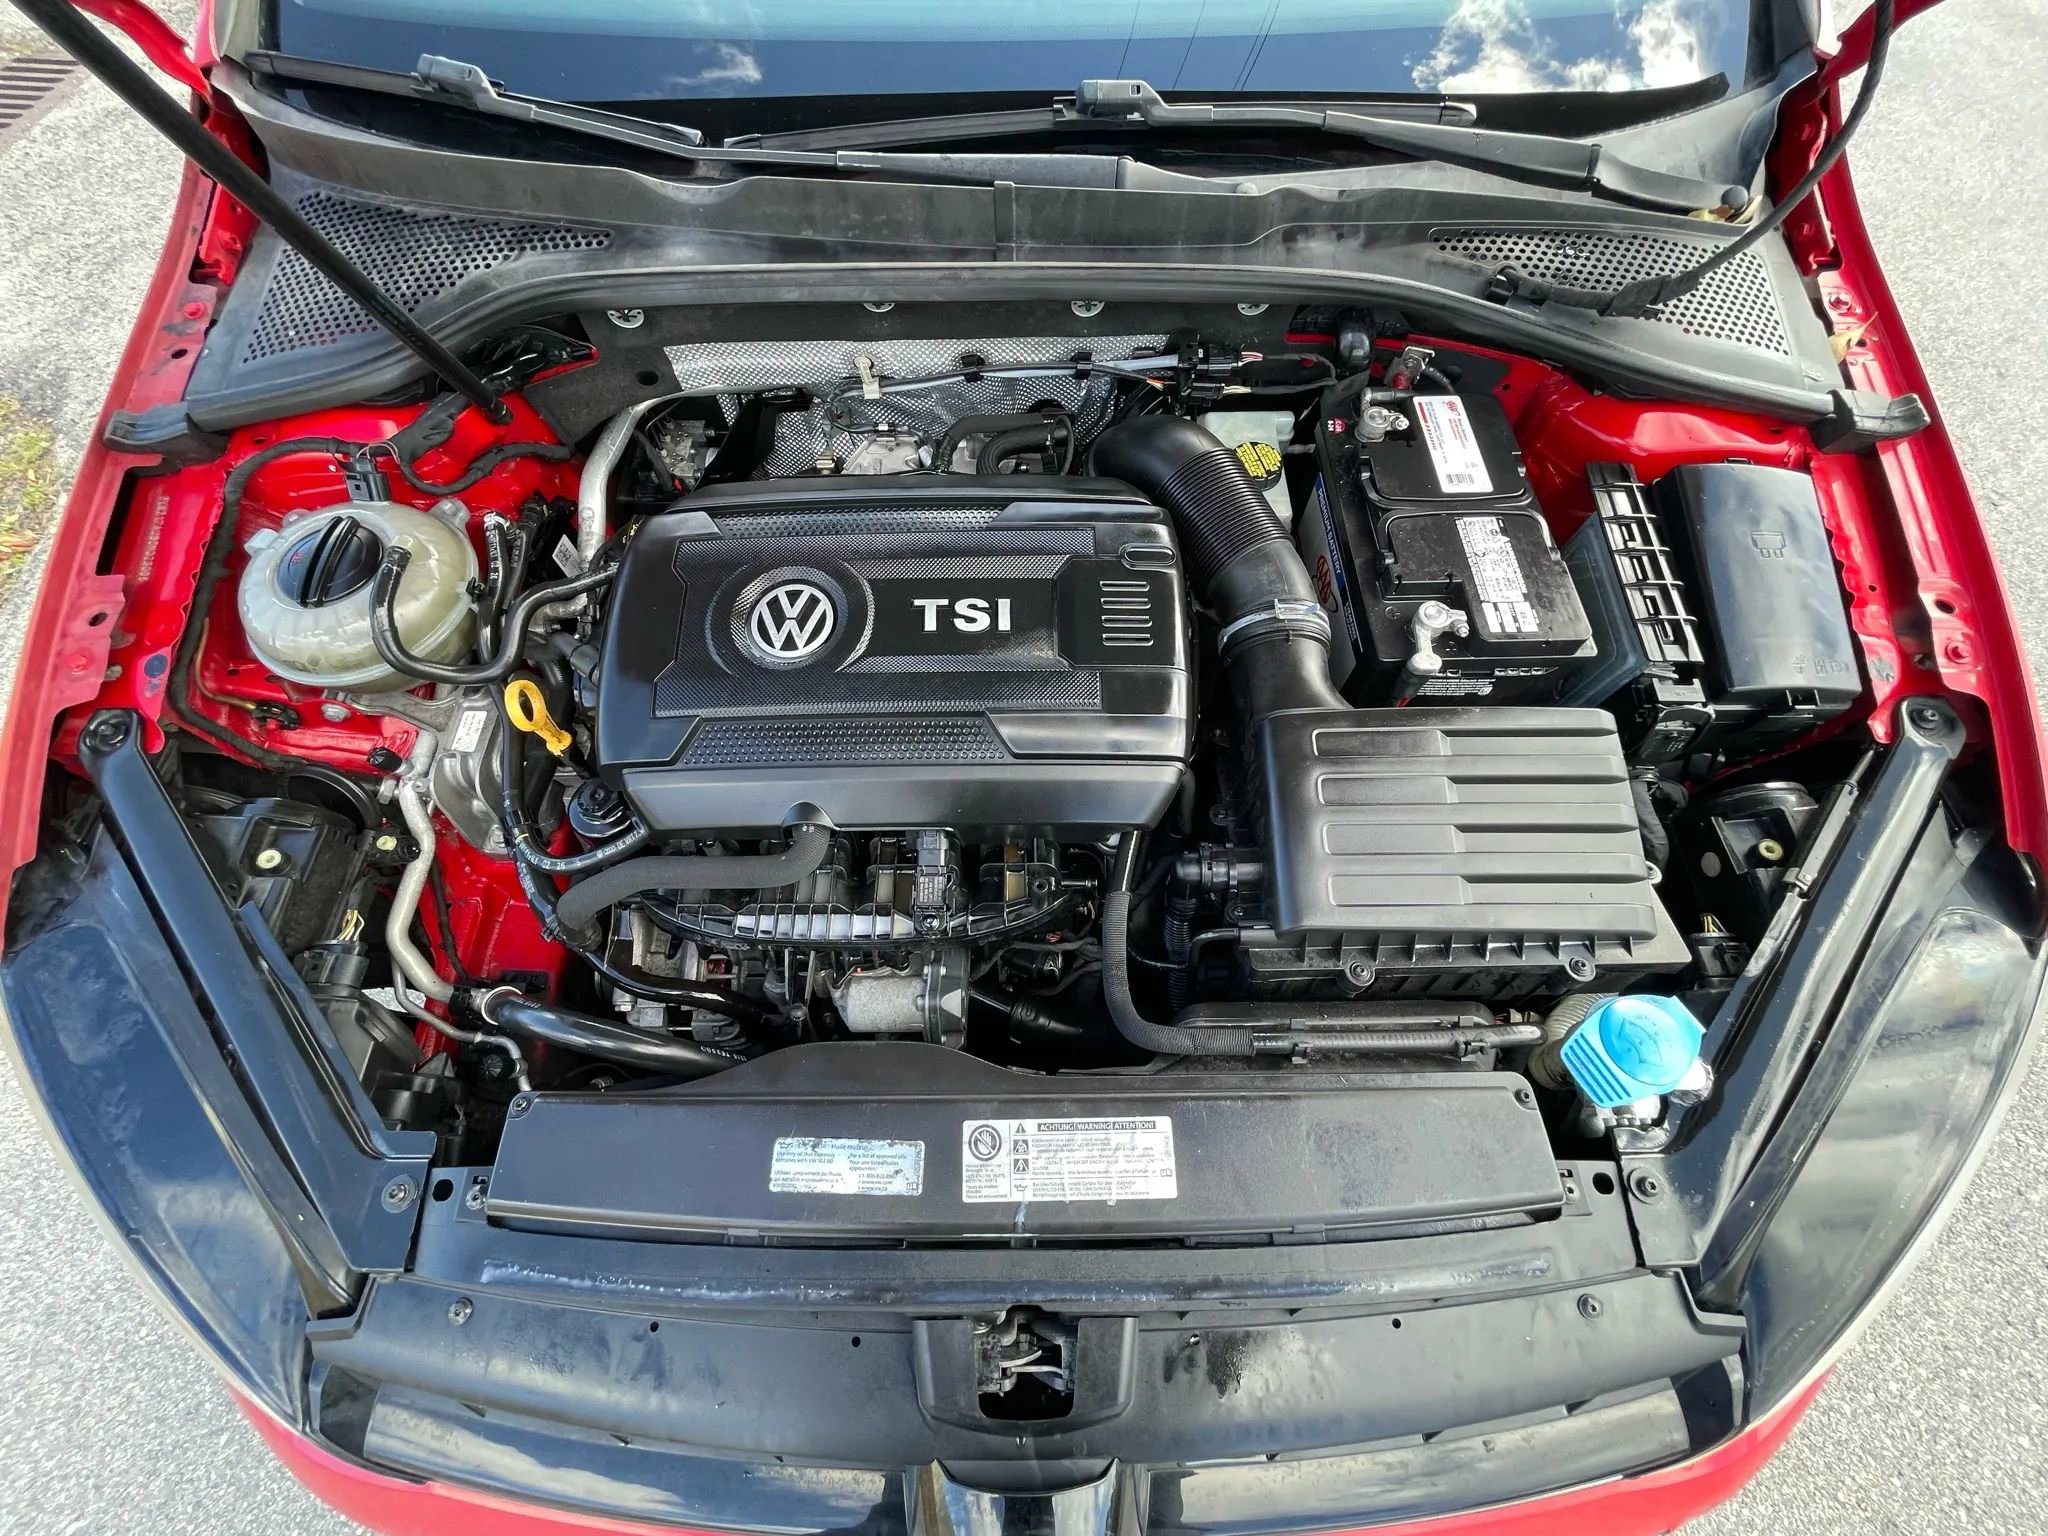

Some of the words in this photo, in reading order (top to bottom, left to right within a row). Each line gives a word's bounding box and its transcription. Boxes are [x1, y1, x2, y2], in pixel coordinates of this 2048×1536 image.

[1318, 488, 1333, 532] PREMIUM
[1327, 531, 1342, 575] BATTERY
[1316, 555, 1332, 605] AAA
[912, 597, 1013, 633] TSI
[1040, 1123, 1076, 1131] ACHTUNG!
[1077, 1122, 1113, 1130] WARNING!
[1114, 1121, 1154, 1130] ATTENTION!
